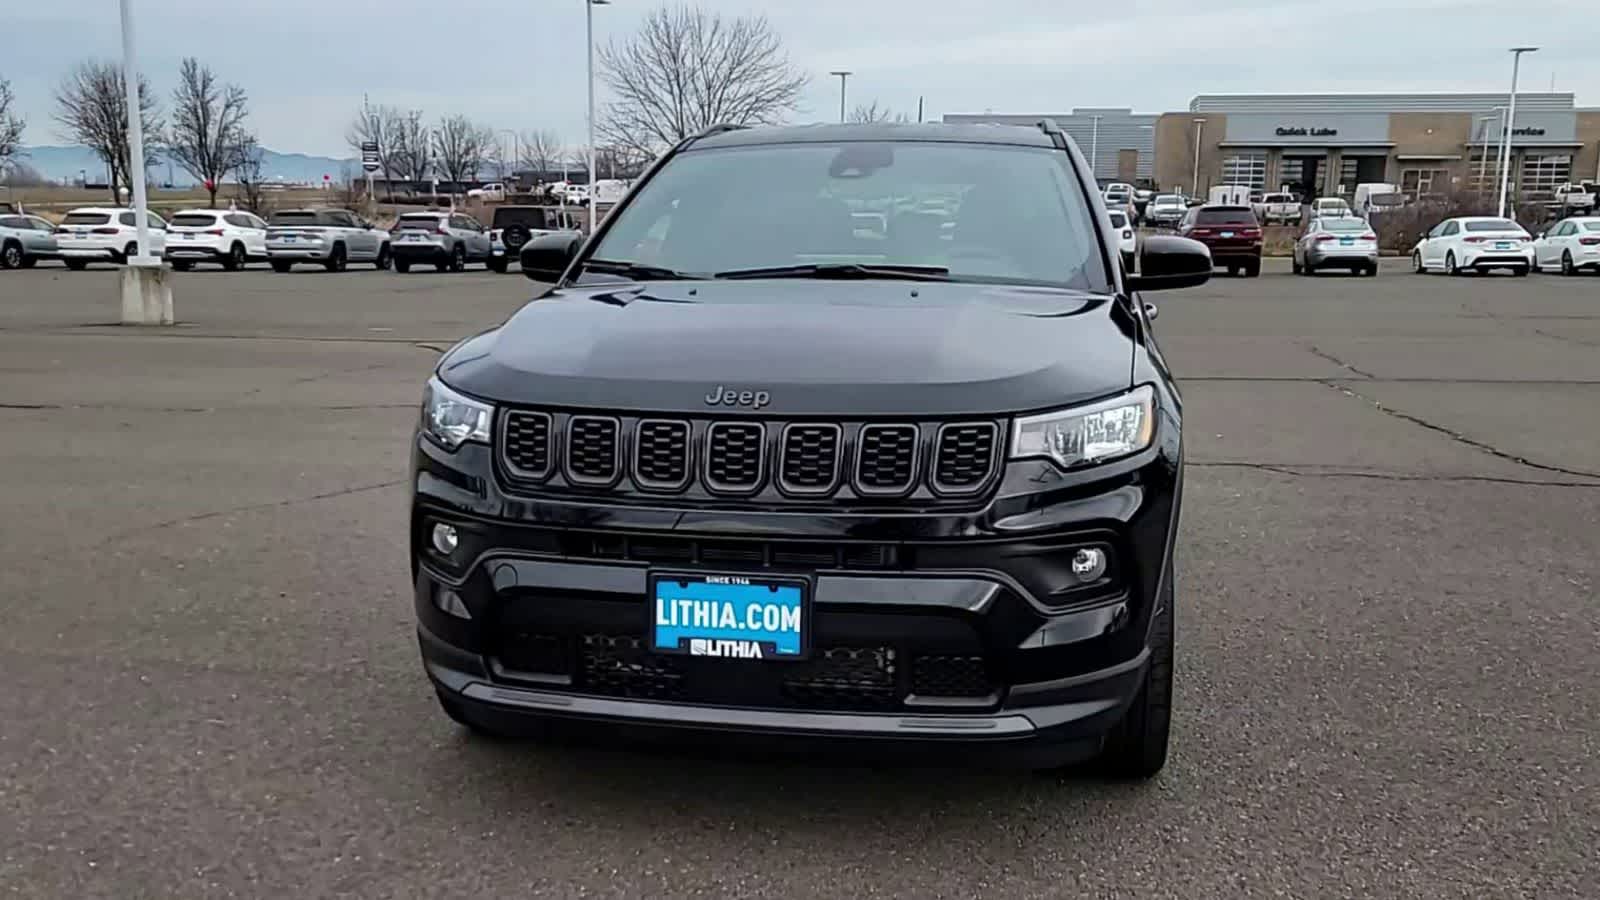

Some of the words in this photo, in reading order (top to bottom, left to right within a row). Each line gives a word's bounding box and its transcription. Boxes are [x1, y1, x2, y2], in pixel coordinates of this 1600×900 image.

[1275, 127, 1307, 136] Quick
[1310, 127, 1337, 136] Lube
[705, 386, 769, 409] Jeep
[705, 576, 730, 584] SINCE
[656, 598, 801, 633] LITHIA.COM
[707, 638, 763, 659] LITHIA
